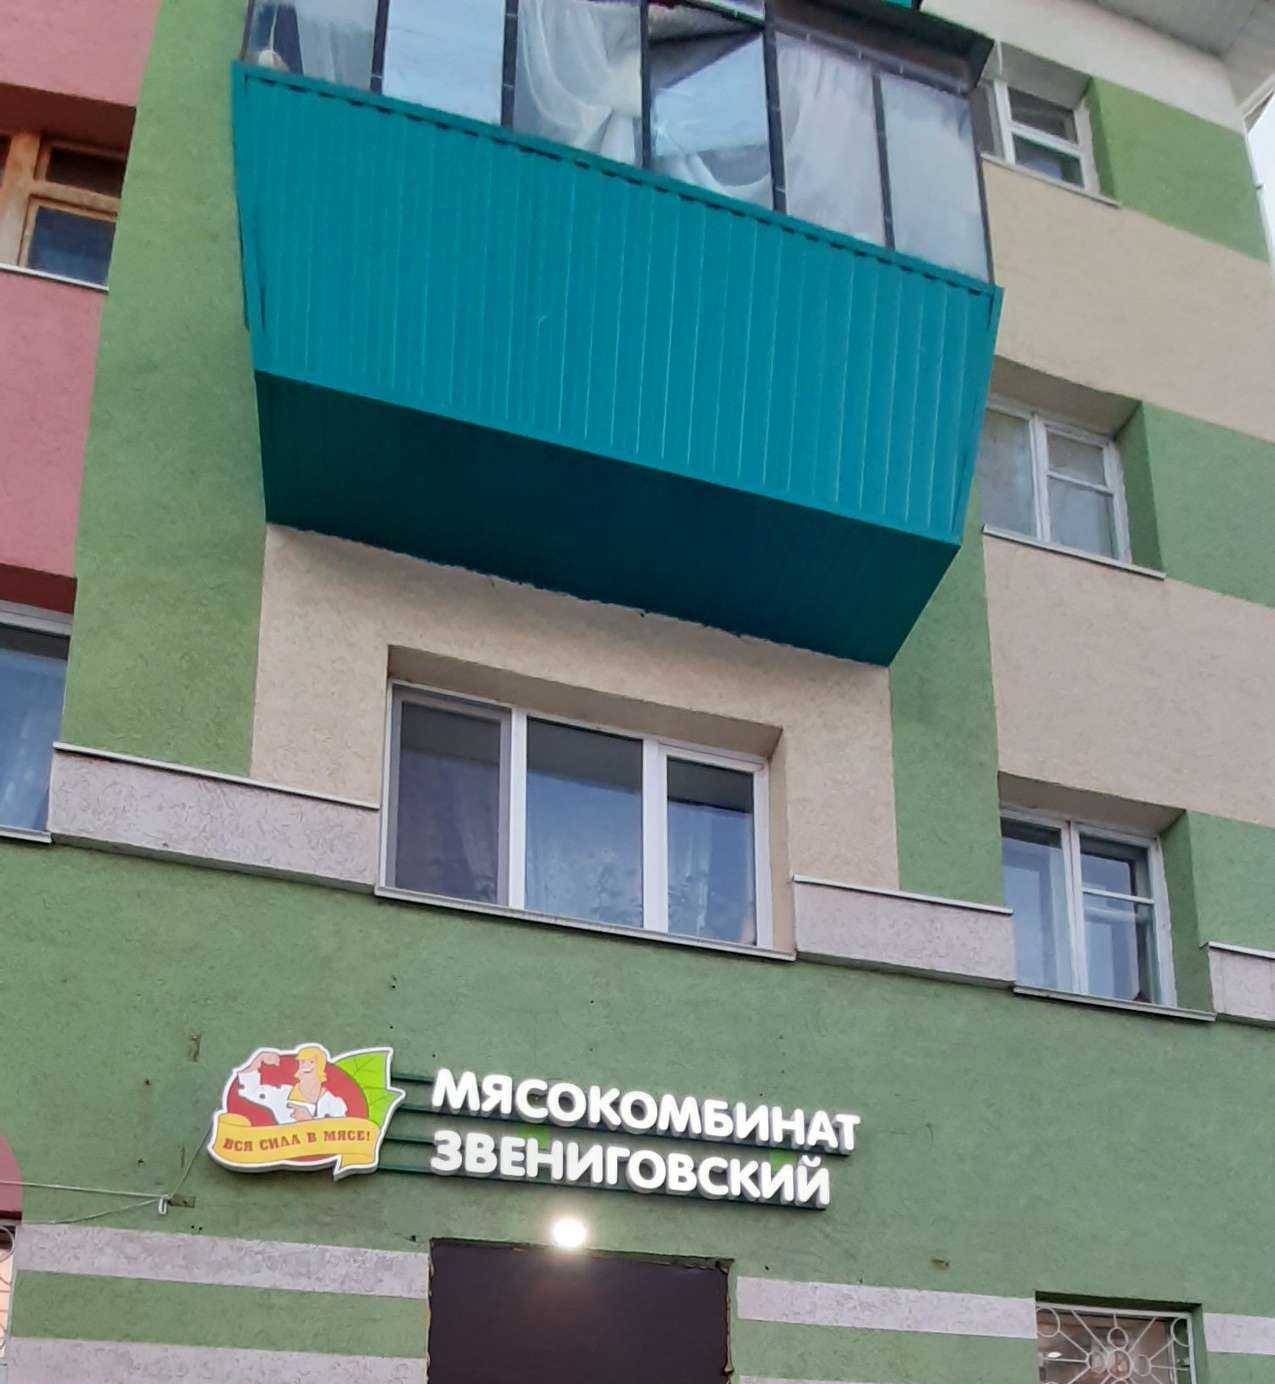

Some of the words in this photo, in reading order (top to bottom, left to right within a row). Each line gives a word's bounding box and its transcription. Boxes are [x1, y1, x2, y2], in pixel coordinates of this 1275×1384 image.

[222, 1137, 253, 1152] ВСЯ
[259, 1133, 301, 1151] СИЛА
[307, 1131, 317, 1143] В
[323, 1130, 371, 1142] МЯСЕ!
[431, 1068, 861, 1152] МЯСОКОМБИНАТ
[430, 1129, 831, 1206] ЗВЕНИГОВСКИЙ
